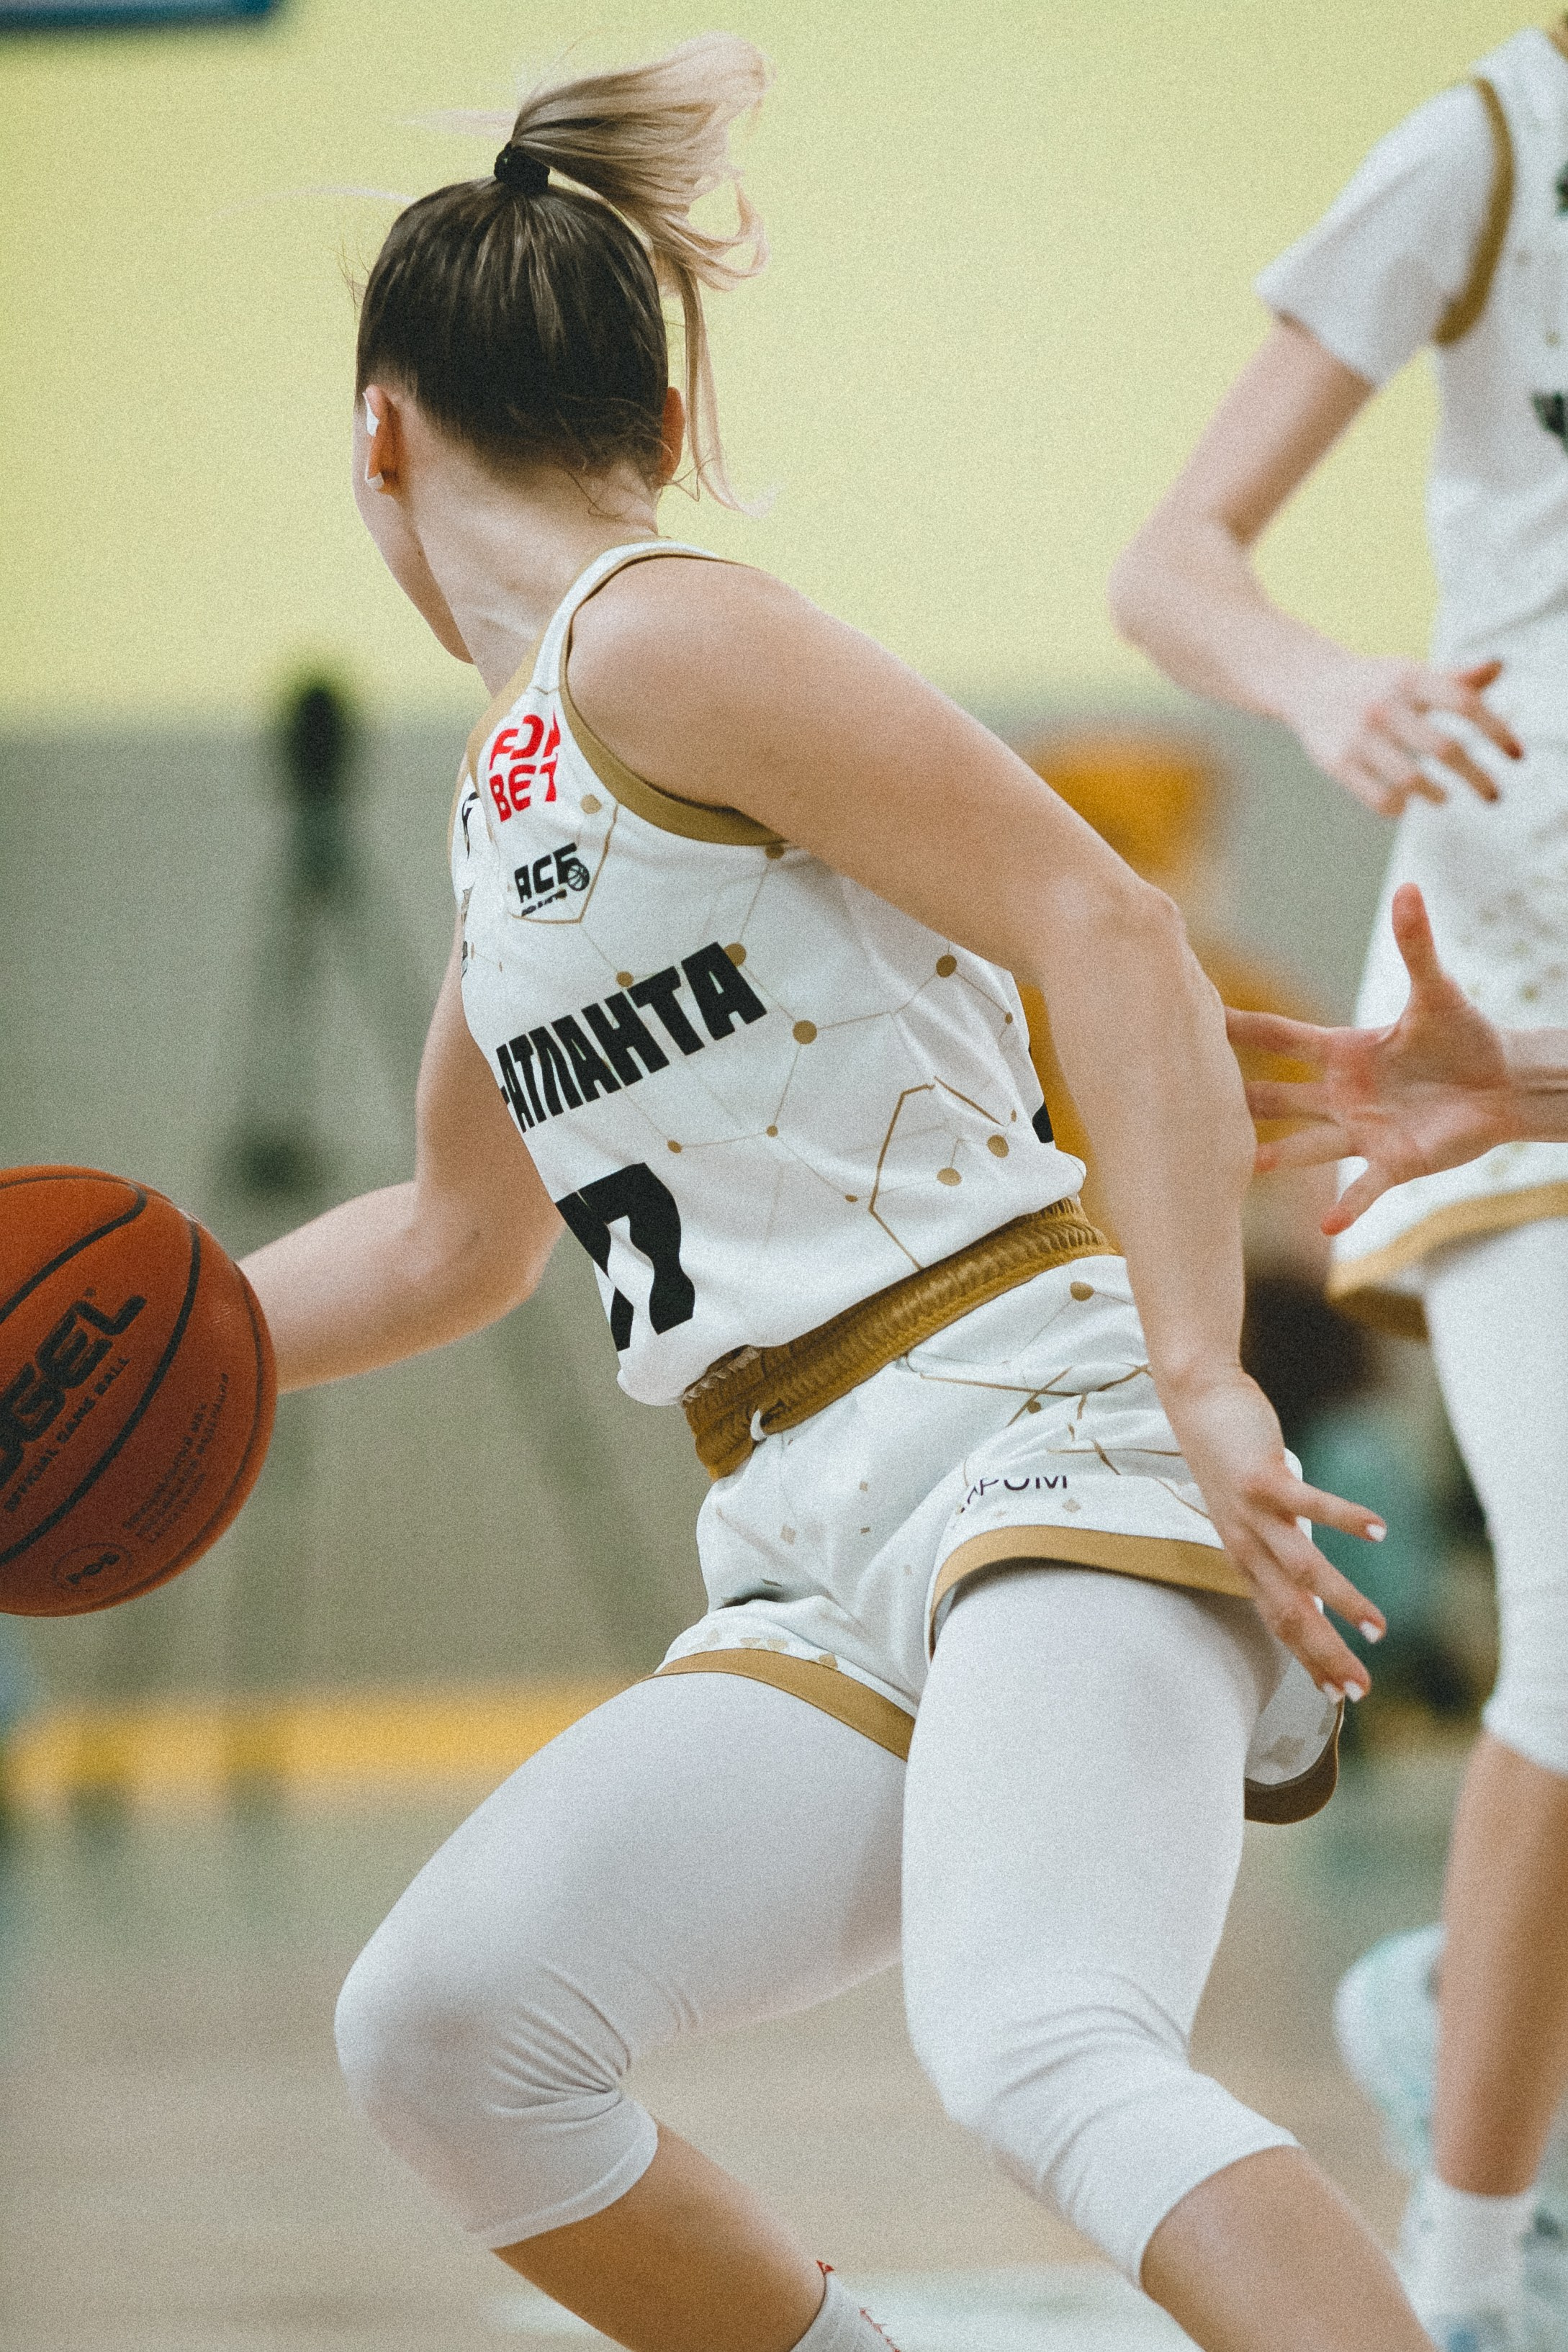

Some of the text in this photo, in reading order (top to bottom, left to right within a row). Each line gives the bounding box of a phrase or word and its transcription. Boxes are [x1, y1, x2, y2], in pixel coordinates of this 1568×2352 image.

[490, 760, 559, 822] BET
[55, 1396, 96, 1444] GAME
[94, 1357, 130, 1397] BALL
